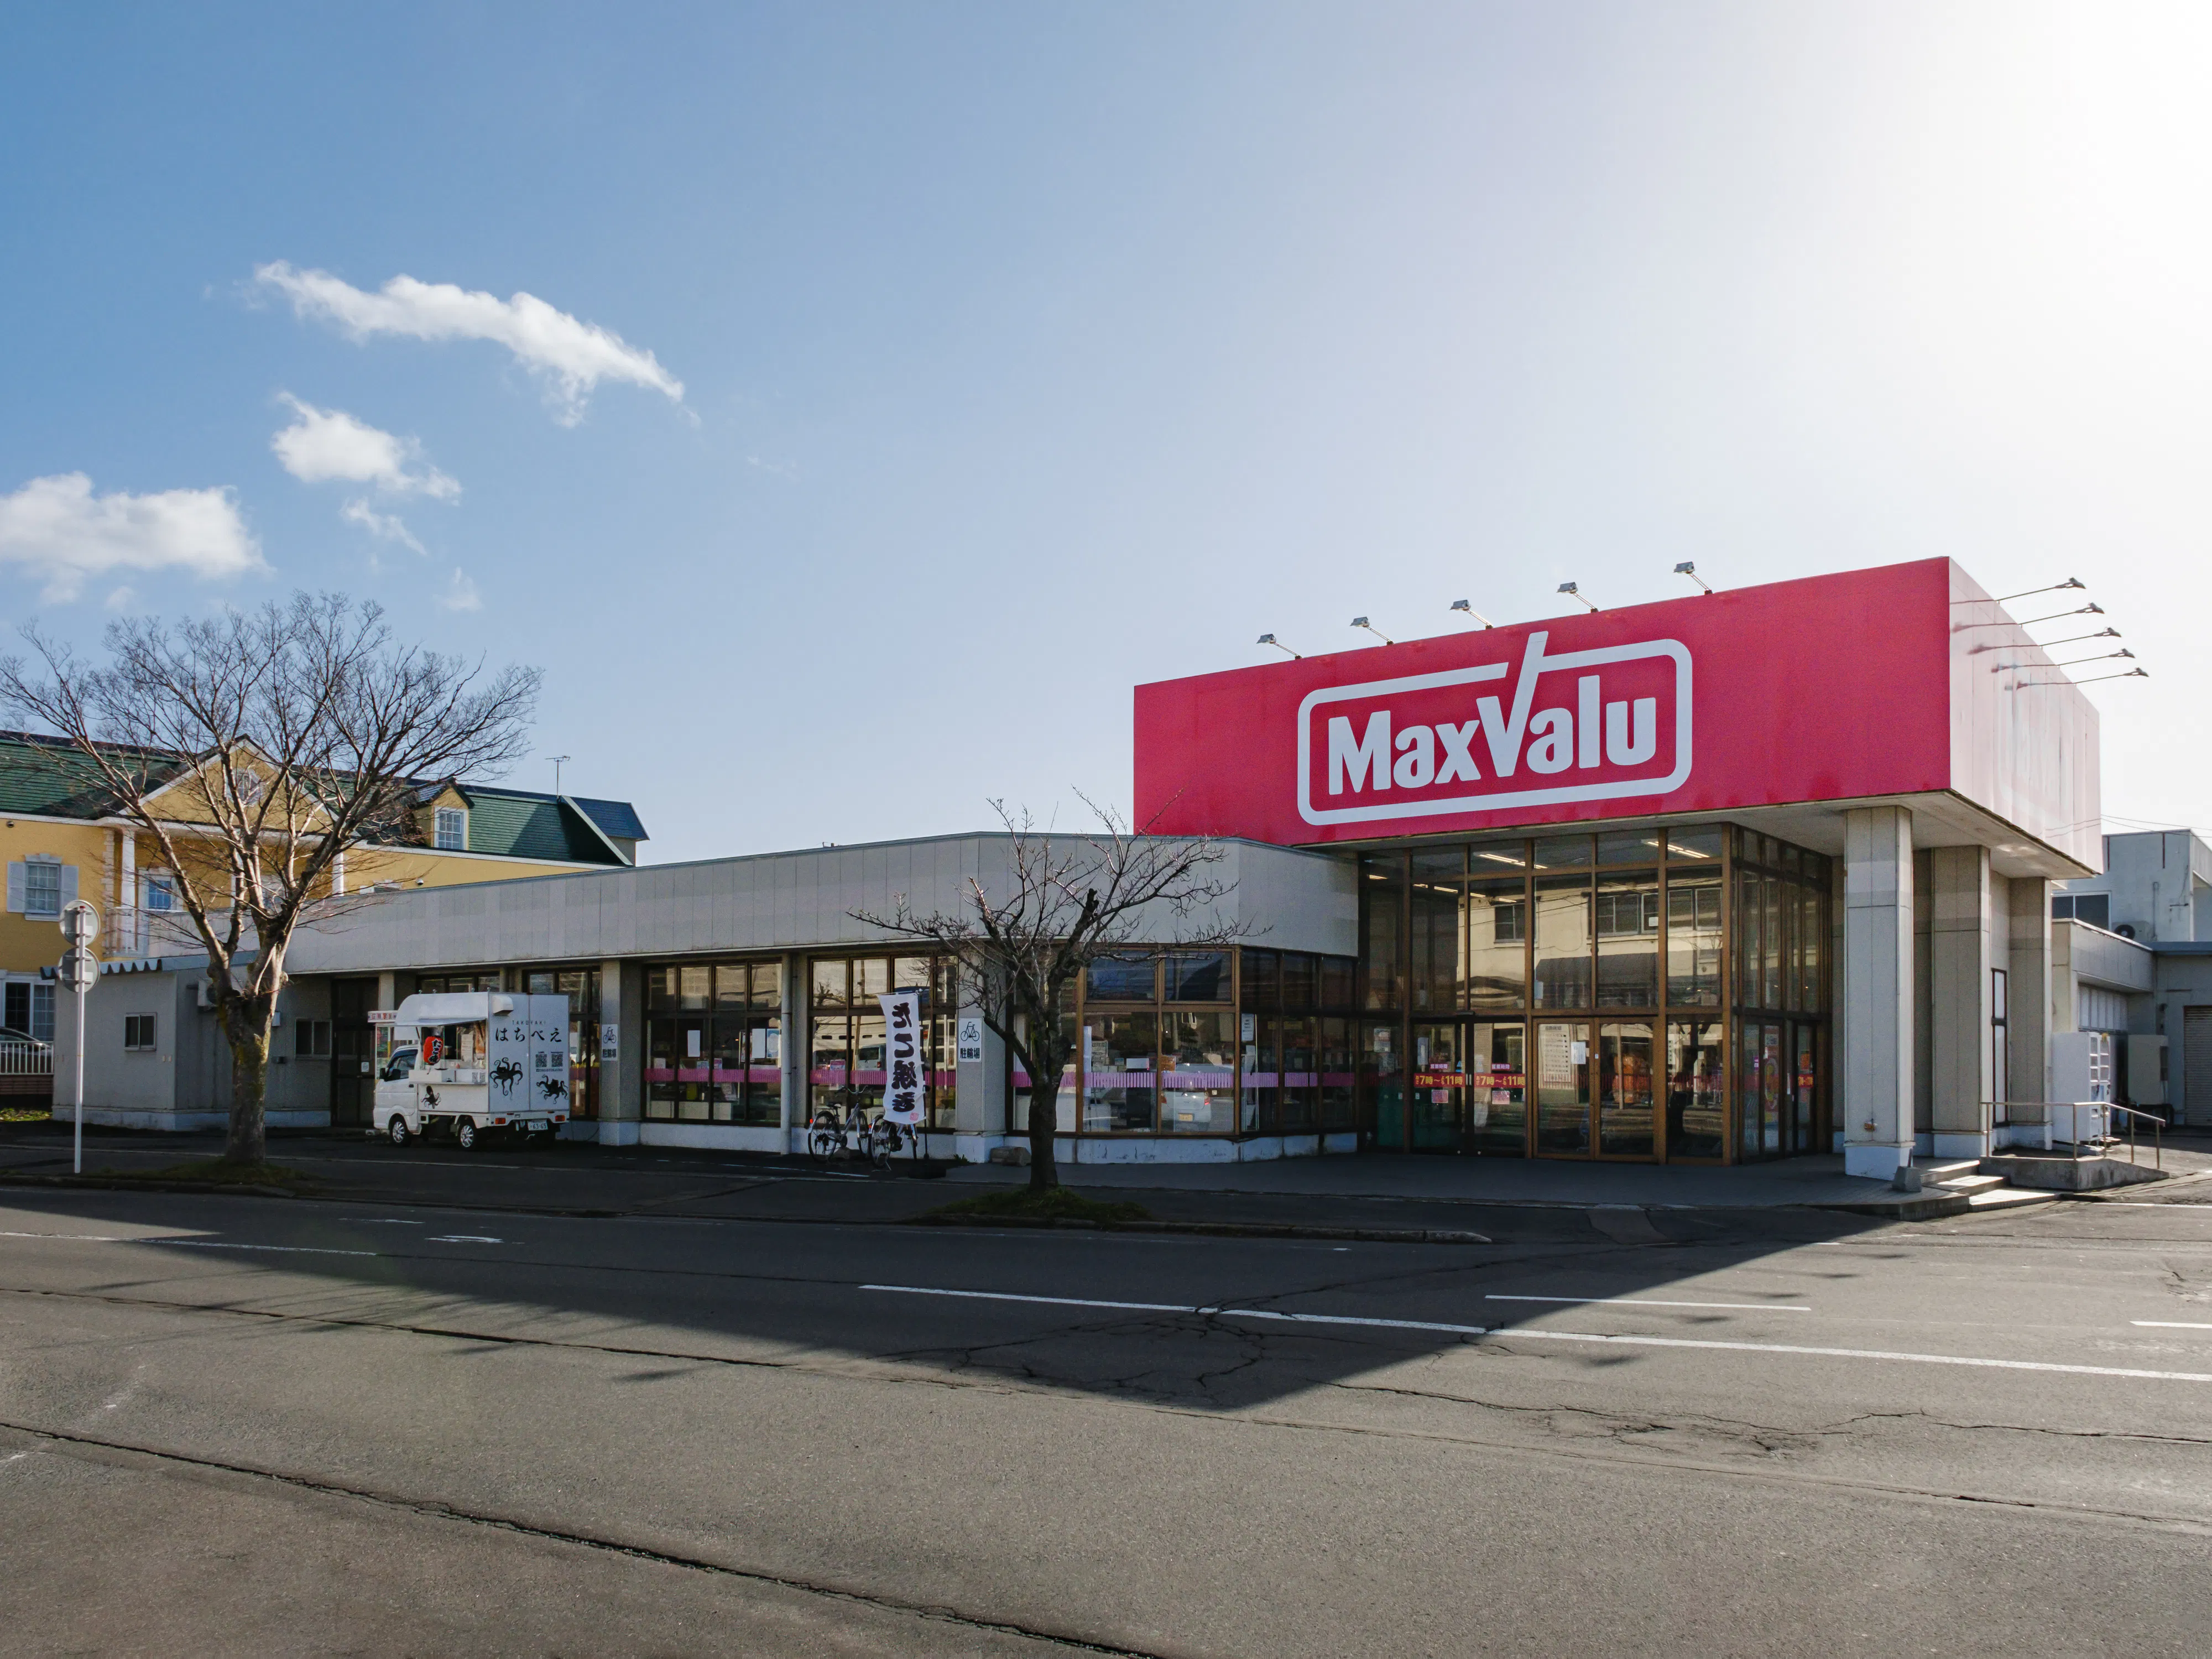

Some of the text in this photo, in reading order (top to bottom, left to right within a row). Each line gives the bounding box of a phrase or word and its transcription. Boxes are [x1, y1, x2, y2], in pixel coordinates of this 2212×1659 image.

[1329, 630, 1656, 795] MaxValu
[495, 1027, 562, 1042] はちべえ
[960, 1047, 980, 1059] 駐輪場
